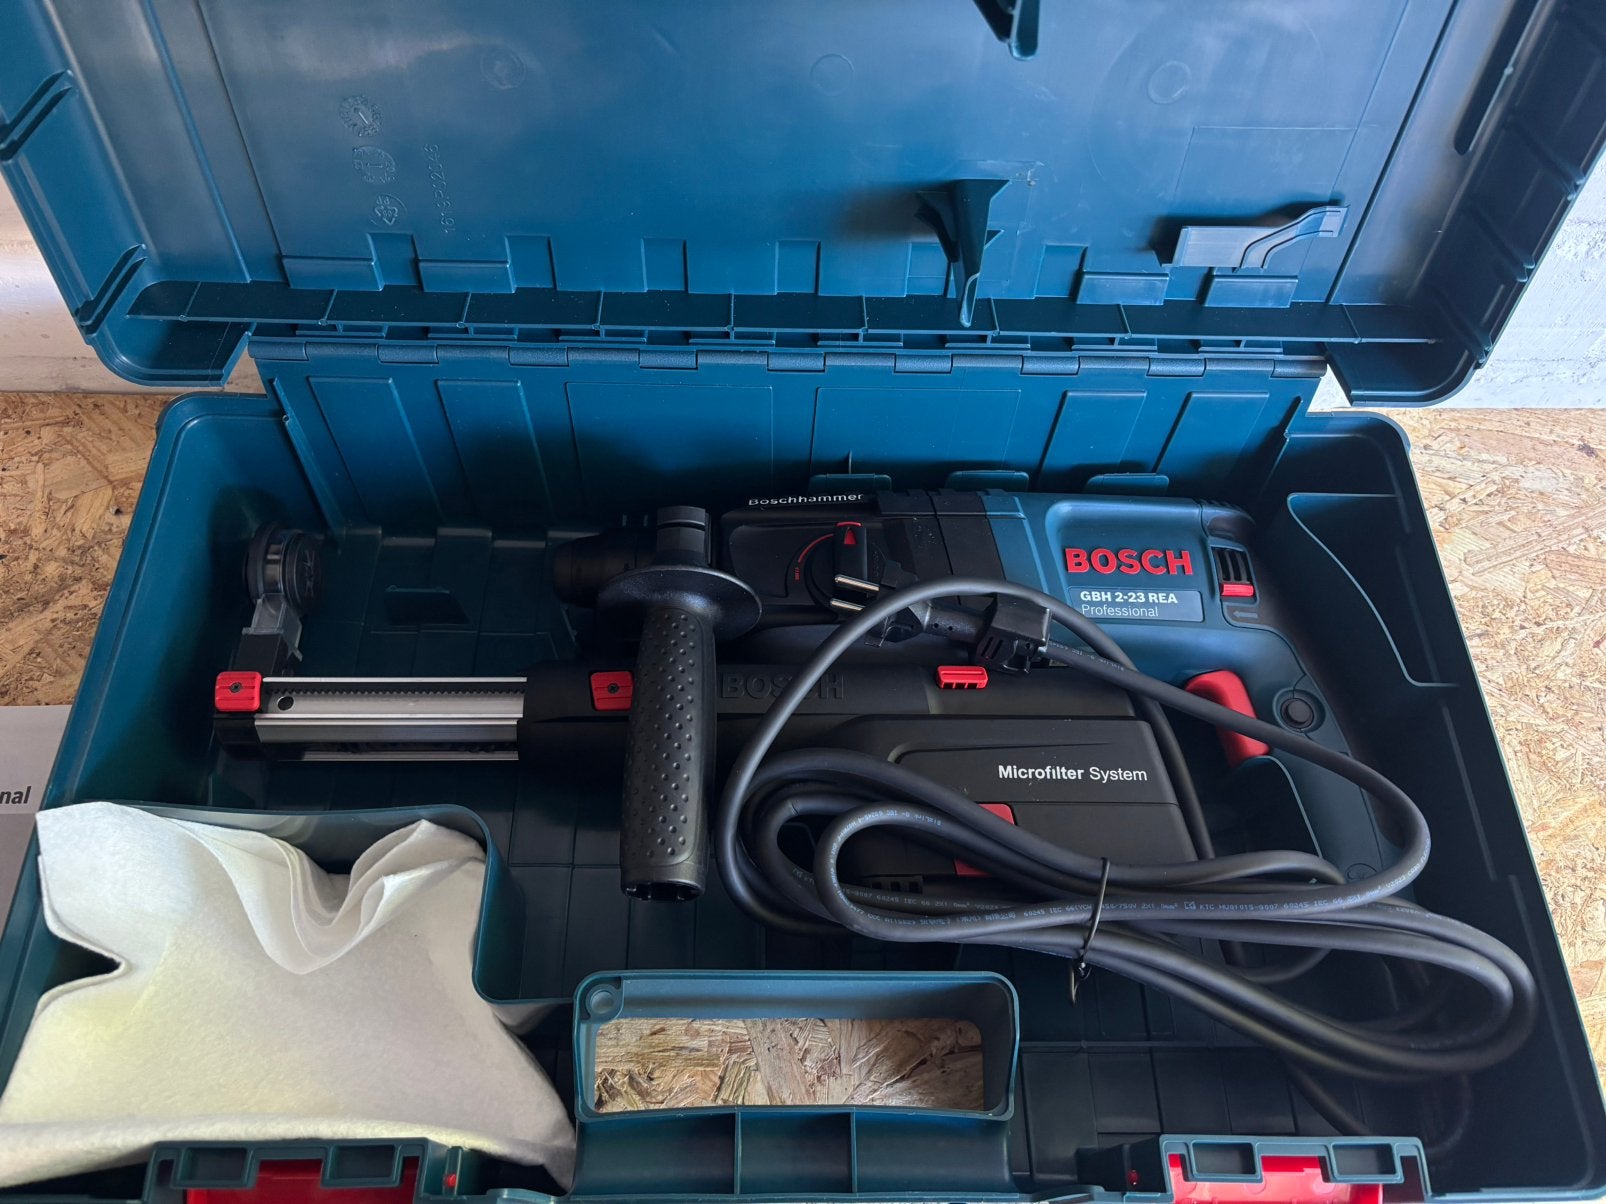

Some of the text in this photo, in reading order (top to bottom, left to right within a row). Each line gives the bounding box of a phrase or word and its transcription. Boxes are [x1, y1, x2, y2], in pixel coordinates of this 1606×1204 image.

[748, 493, 864, 506] Boschhammer
[1064, 547, 1194, 575] BOSCH
[1080, 590, 1178, 604] GBH 2-23 REA
[1081, 604, 1159, 618] Professional
[721, 672, 844, 700] BOSH
[998, 765, 1148, 783] Microfilter System
